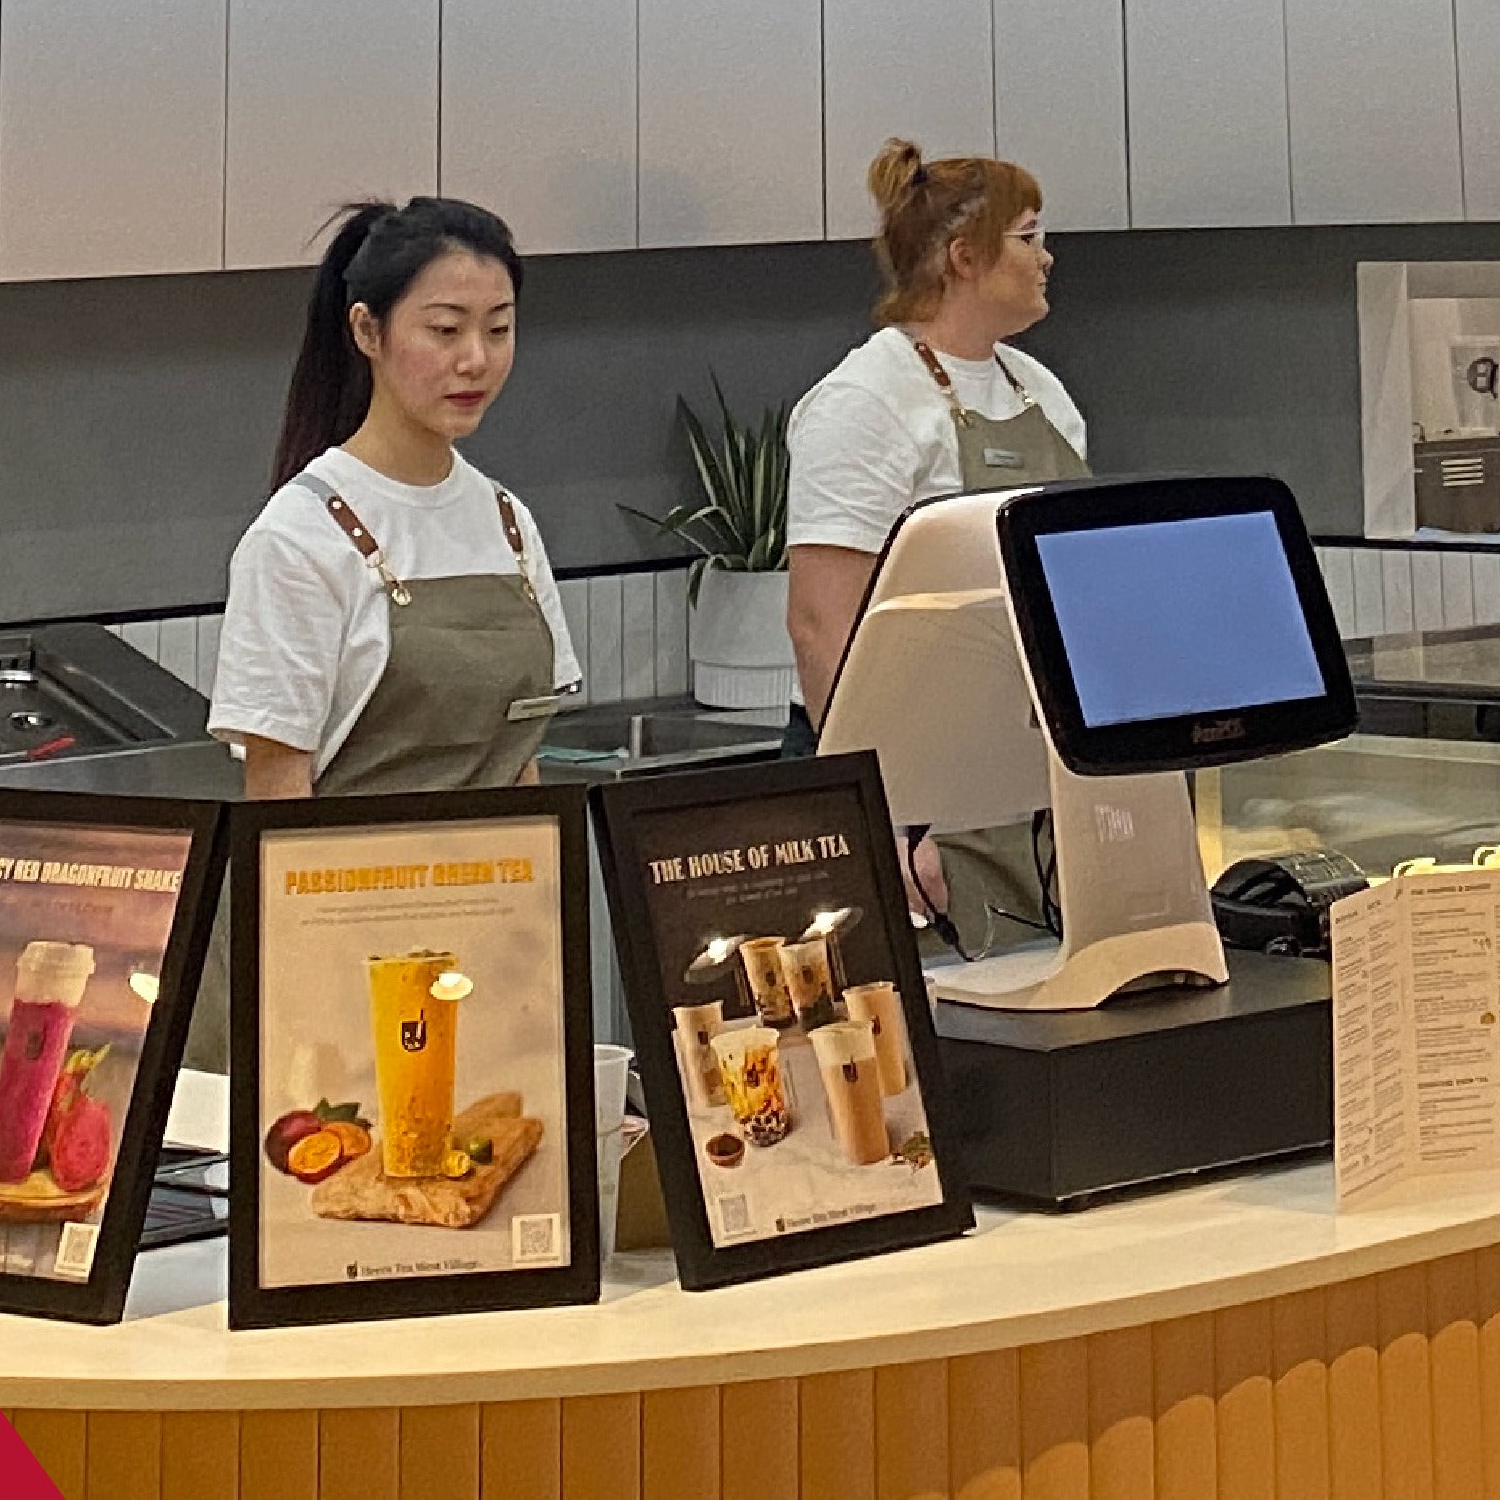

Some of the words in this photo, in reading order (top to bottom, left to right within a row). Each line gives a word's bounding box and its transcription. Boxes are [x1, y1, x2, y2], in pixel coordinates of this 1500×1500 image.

[13, 859, 40, 882] RED
[40, 861, 135, 889] DRAGONFRUIT
[133, 869, 181, 893] SHAKE
[284, 865, 429, 895] PASSIONFRUIT
[432, 860, 494, 887] GREEN
[496, 856, 533, 884] TEA
[648, 857, 685, 884] THE
[687, 849, 745, 879] HOUSE
[748, 844, 769, 869] OF
[774, 838, 815, 865] MILK
[817, 833, 850, 859] TEA
